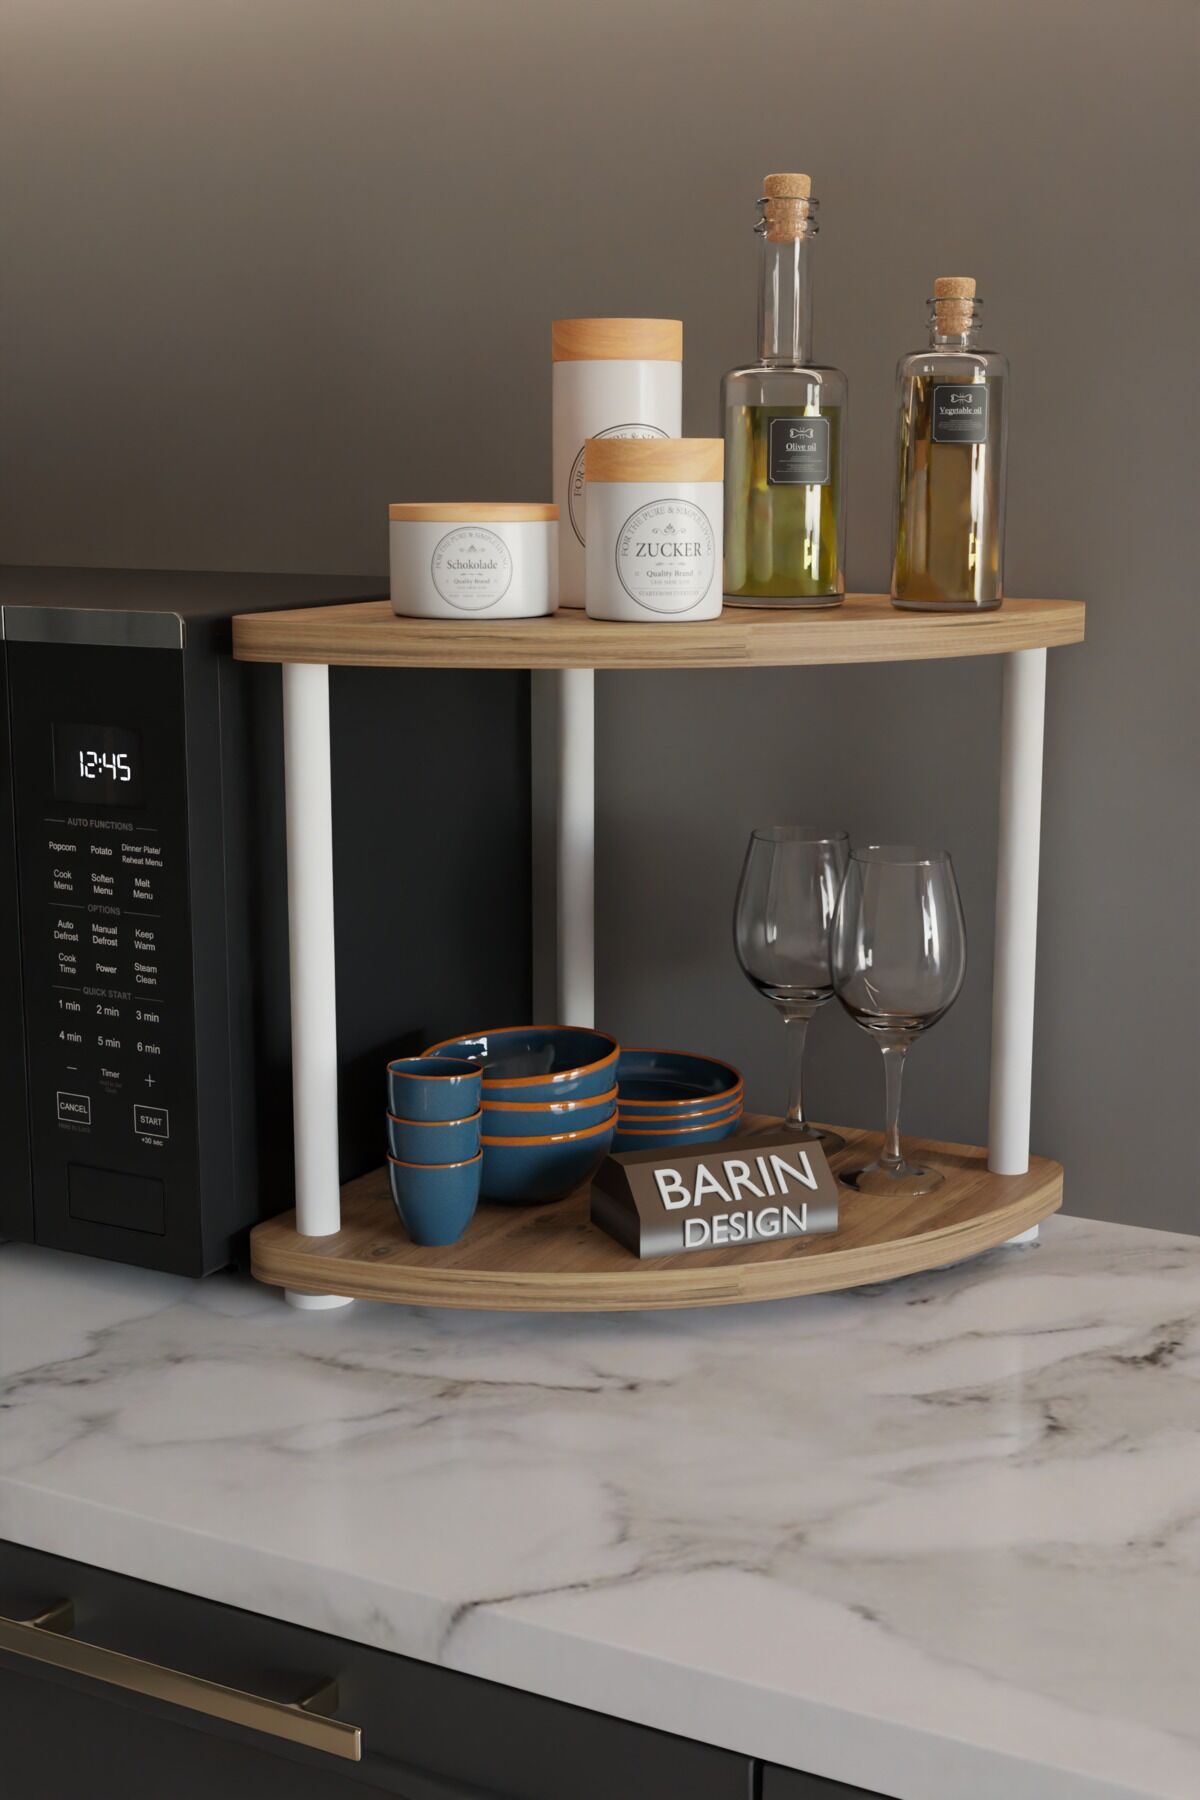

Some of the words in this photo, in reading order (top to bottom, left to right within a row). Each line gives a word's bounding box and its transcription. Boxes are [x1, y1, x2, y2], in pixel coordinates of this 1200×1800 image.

[939, 406, 972, 416] Vegetable
[973, 407, 982, 415] oil
[785, 442, 806, 451] Olive
[807, 442, 817, 451] oil
[635, 541, 702, 558] ZUCKER
[447, 559, 498, 570] Schokolade
[79, 750, 131, 782] 12:45
[67, 817, 88, 828] AUTO
[89, 818, 134, 832] FUNCTIONS
[49, 841, 77, 853] Popcorn
[90, 845, 113, 857] Potato
[121, 843, 142, 854] Dinner
[121, 855, 144, 866] Reheat
[144, 857, 163, 867] Menu
[53, 869, 72, 880] Cook
[91, 873, 114, 885] Soften
[53, 880, 73, 892] Menu
[134, 878, 151, 889] Melt
[93, 885, 113, 897] Menu
[133, 889, 154, 901] Menu
[87, 903, 121, 916] OPTIONS
[57, 919, 75, 930] Auto
[91, 923, 118, 935] Manual
[53, 930, 79, 942] Defrost
[135, 928, 155, 940] Keep
[92, 935, 118, 947] Defrost
[134, 940, 156, 952] Warm
[58, 952, 77, 963] Cook
[59, 963, 77, 975] Time
[95, 963, 118, 974] Power
[134, 962, 158, 974] Steam
[135, 974, 157, 986] Clean
[82, 986, 107, 998] QUICK
[108, 989, 132, 1001] START
[58, 999, 63, 1009] 1
[65, 1001, 81, 1012] min
[96, 1004, 102, 1015] 2
[103, 1006, 120, 1017] min
[136, 1010, 142, 1021] 3
[143, 1012, 160, 1023] min
[59, 1030, 65, 1041] 4
[66, 1031, 82, 1043] min
[97, 1036, 103, 1046] 5
[104, 1037, 121, 1049] min
[137, 1042, 143, 1052] 6
[144, 1043, 161, 1055] min
[101, 1067, 121, 1080] Timer
[59, 1101, 88, 1114] CANCEL
[140, 1115, 164, 1127] START
[652, 1150, 819, 1211] BARIN
[683, 1202, 808, 1249] DESIGN
